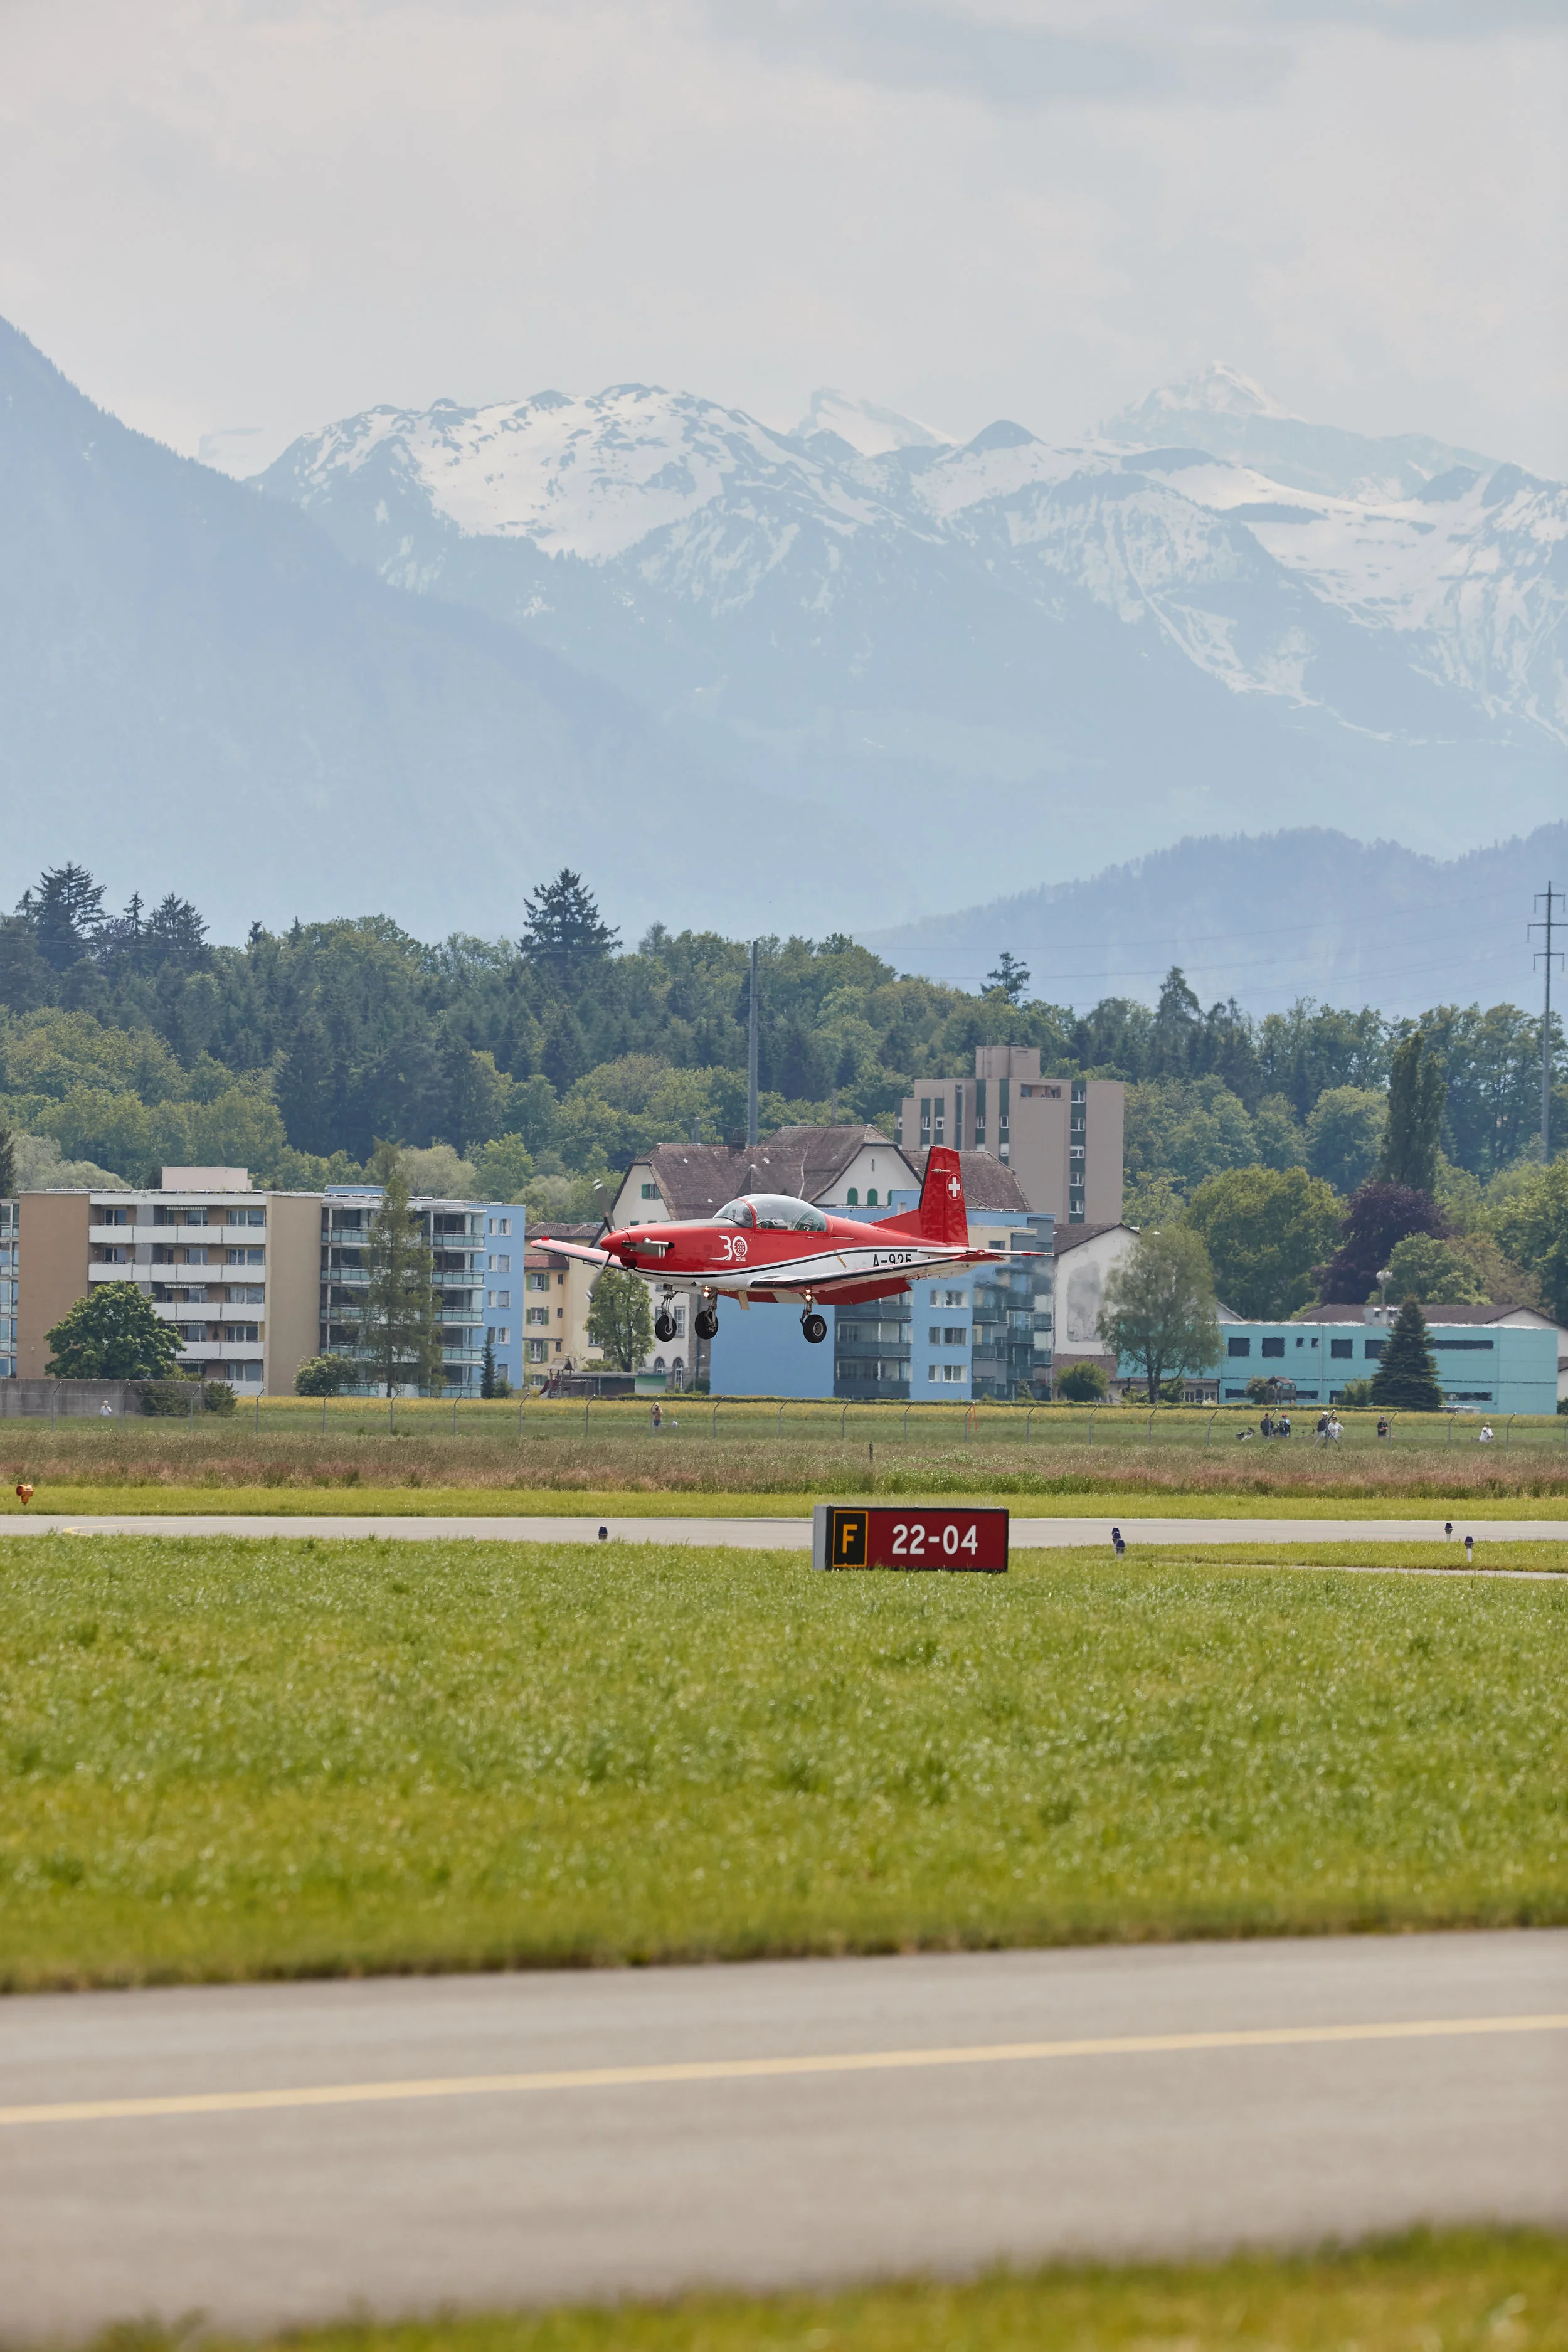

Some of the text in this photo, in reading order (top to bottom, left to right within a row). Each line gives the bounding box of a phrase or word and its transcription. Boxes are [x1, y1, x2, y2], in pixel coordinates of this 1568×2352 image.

[707, 1235, 748, 1260] 30
[842, 1524, 978, 1555] F 22-04
